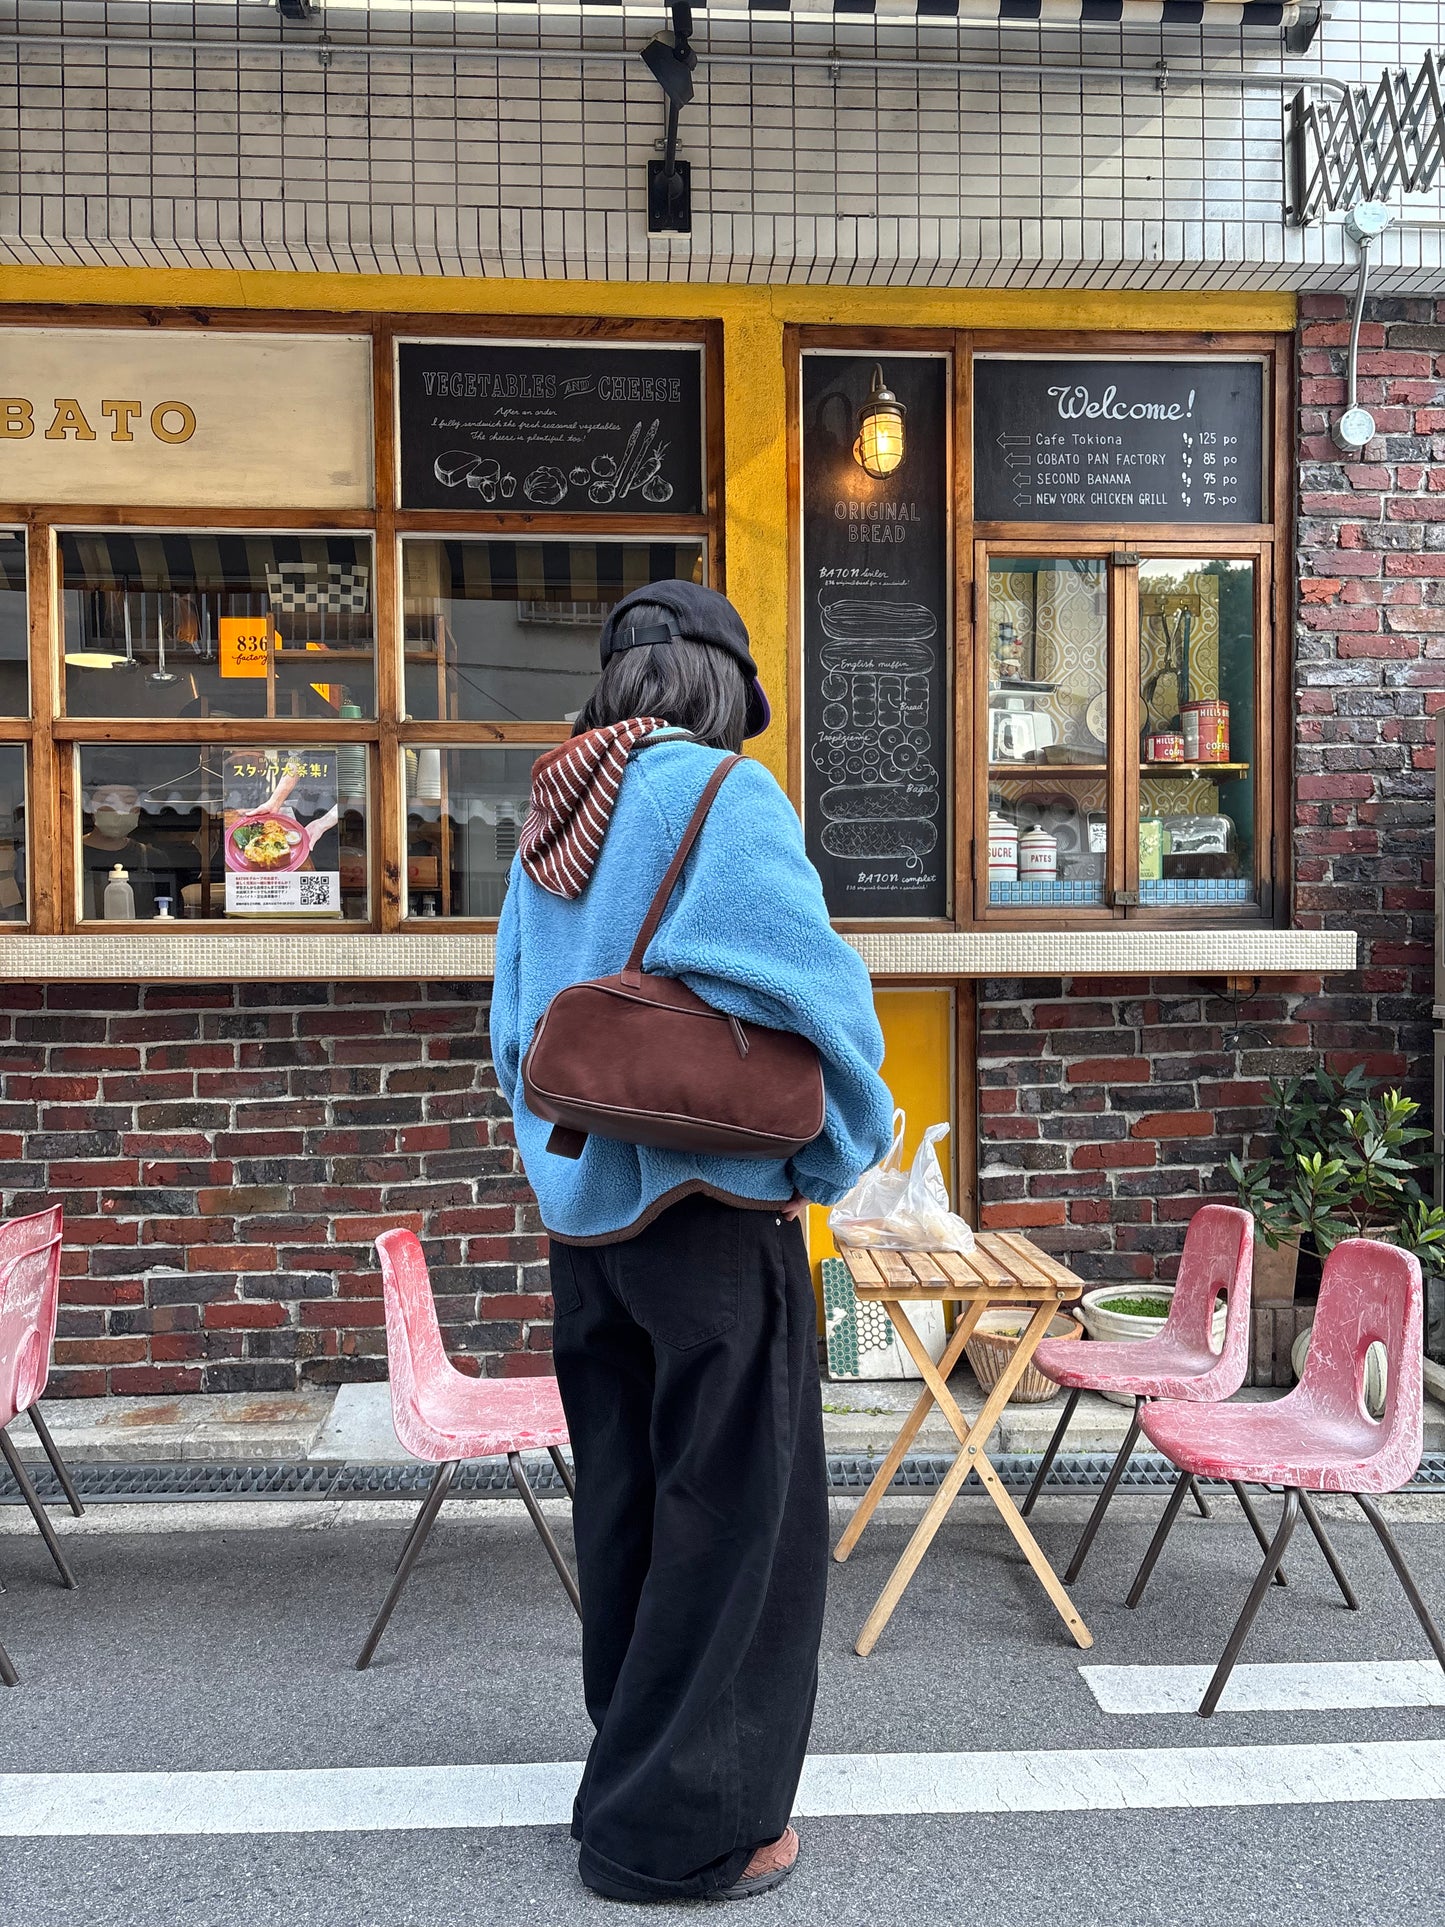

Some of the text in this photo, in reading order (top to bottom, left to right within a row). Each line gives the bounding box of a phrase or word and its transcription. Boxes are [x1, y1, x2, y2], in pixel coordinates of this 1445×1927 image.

[422, 371, 681, 402] VEGETABLES AND CHEESE
[1047, 385, 1196, 421] Welcome!
[534, 408, 558, 416] order
[0, 397, 196, 444] BATO
[461, 420, 501, 428] sandwich
[503, 420, 516, 428] the
[518, 420, 540, 430] fresh
[541, 421, 578, 429] seasonal
[579, 421, 621, 433] vegetables
[470, 431, 486, 440] The
[489, 432, 515, 441] cheese
[1036, 432, 1238, 447] Cafe Tokiona 125 po
[1036, 452, 1238, 467] COBATO PAN FACTORY 85 po
[1036, 472, 1238, 486] SECOND BANANA 95 po
[1036, 492, 1237, 506] NEW YORK CHICKEN GRILL 75 po
[834, 500, 920, 521] ORIGINAL
[848, 524, 906, 543] BREAD
[819, 566, 860, 578] BATON
[231, 635, 268, 665] 836 factory
[840, 659, 909, 671] English muffin
[900, 702, 923, 711] Bread
[1200, 708, 1221, 717] HILLS
[1156, 737, 1174, 745] HILLS
[906, 783, 936, 797] Bagel
[988, 847, 1012, 858] SUCRE
[1030, 854, 1052, 863] PATES
[857, 871, 936, 885] BATON complet
